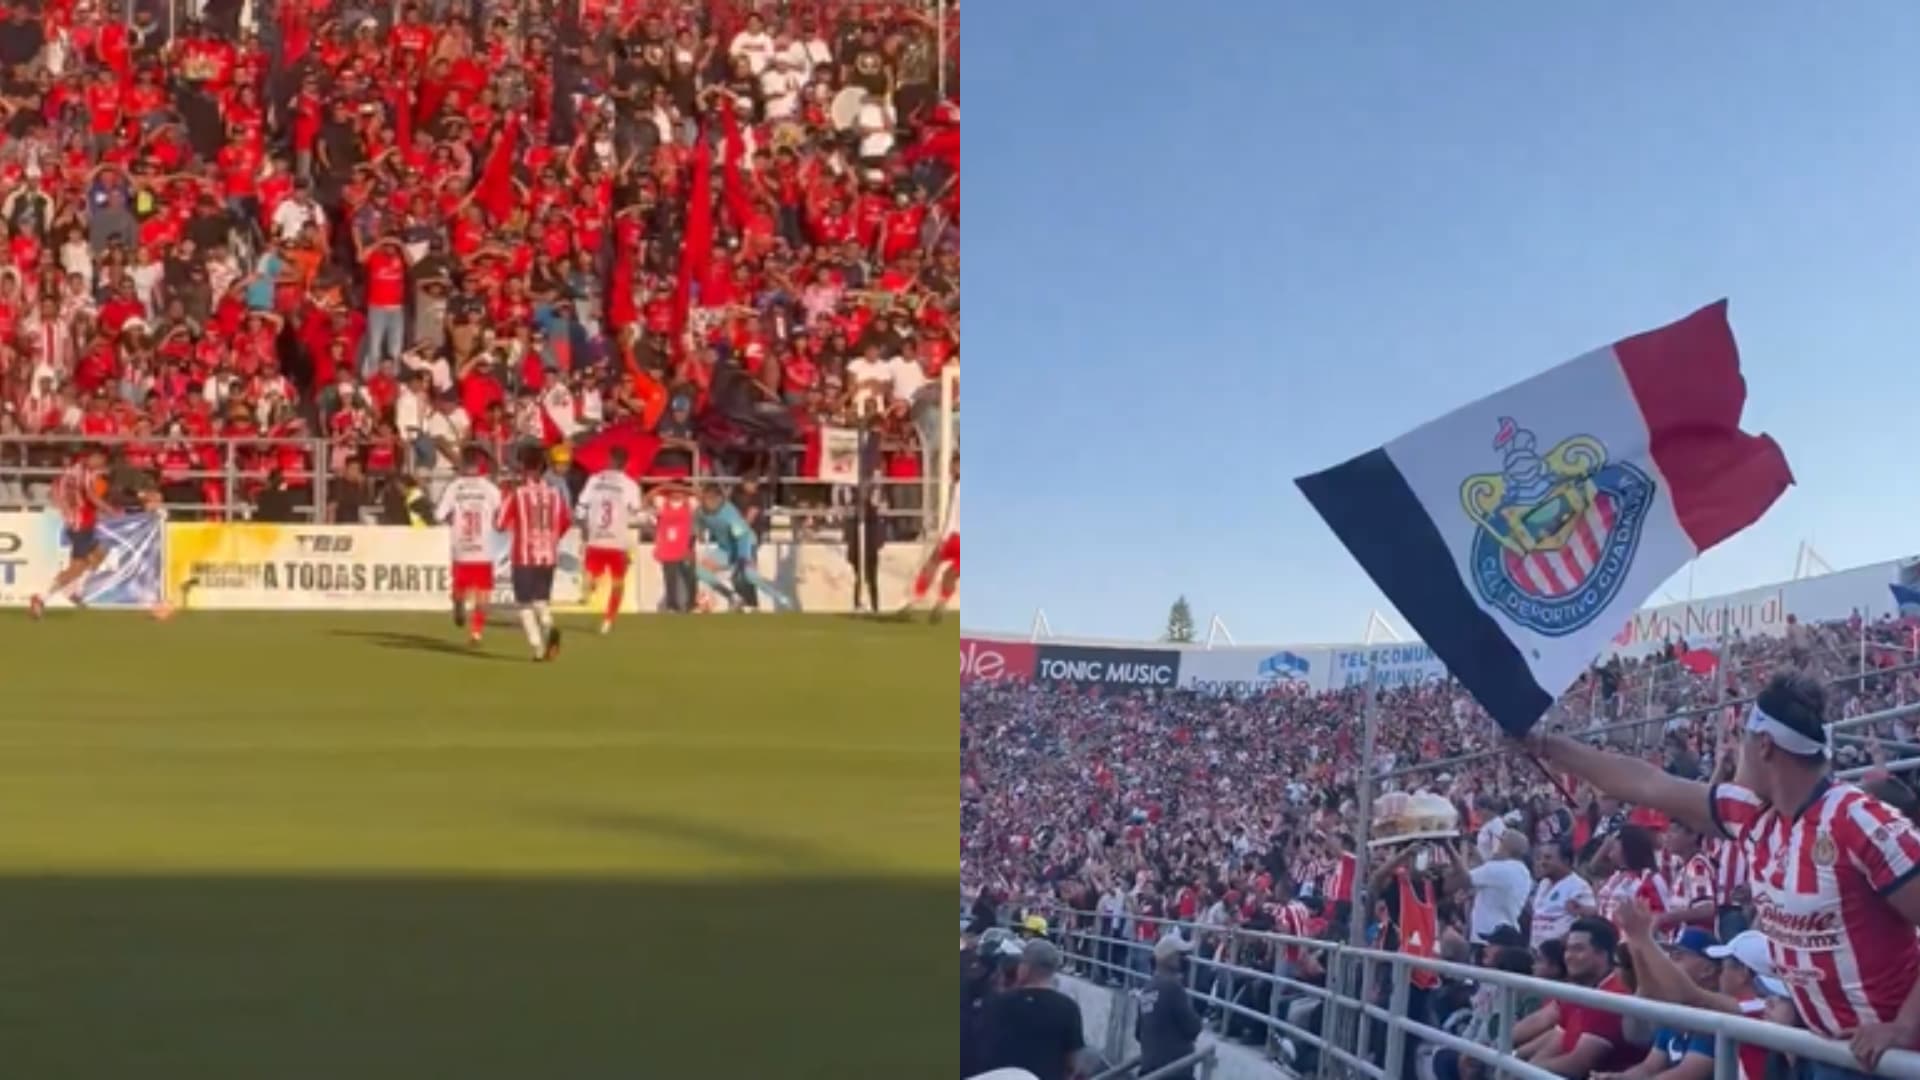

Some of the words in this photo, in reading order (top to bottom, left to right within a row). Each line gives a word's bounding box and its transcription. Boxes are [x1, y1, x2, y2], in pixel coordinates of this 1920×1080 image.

[264, 562, 279, 589] A
[284, 562, 367, 591] TODAS
[1507, 589, 1599, 623] DEPORTIVO
[1040, 658, 1101, 682] TONIC
[1104, 662, 1173, 685] MUSIC
